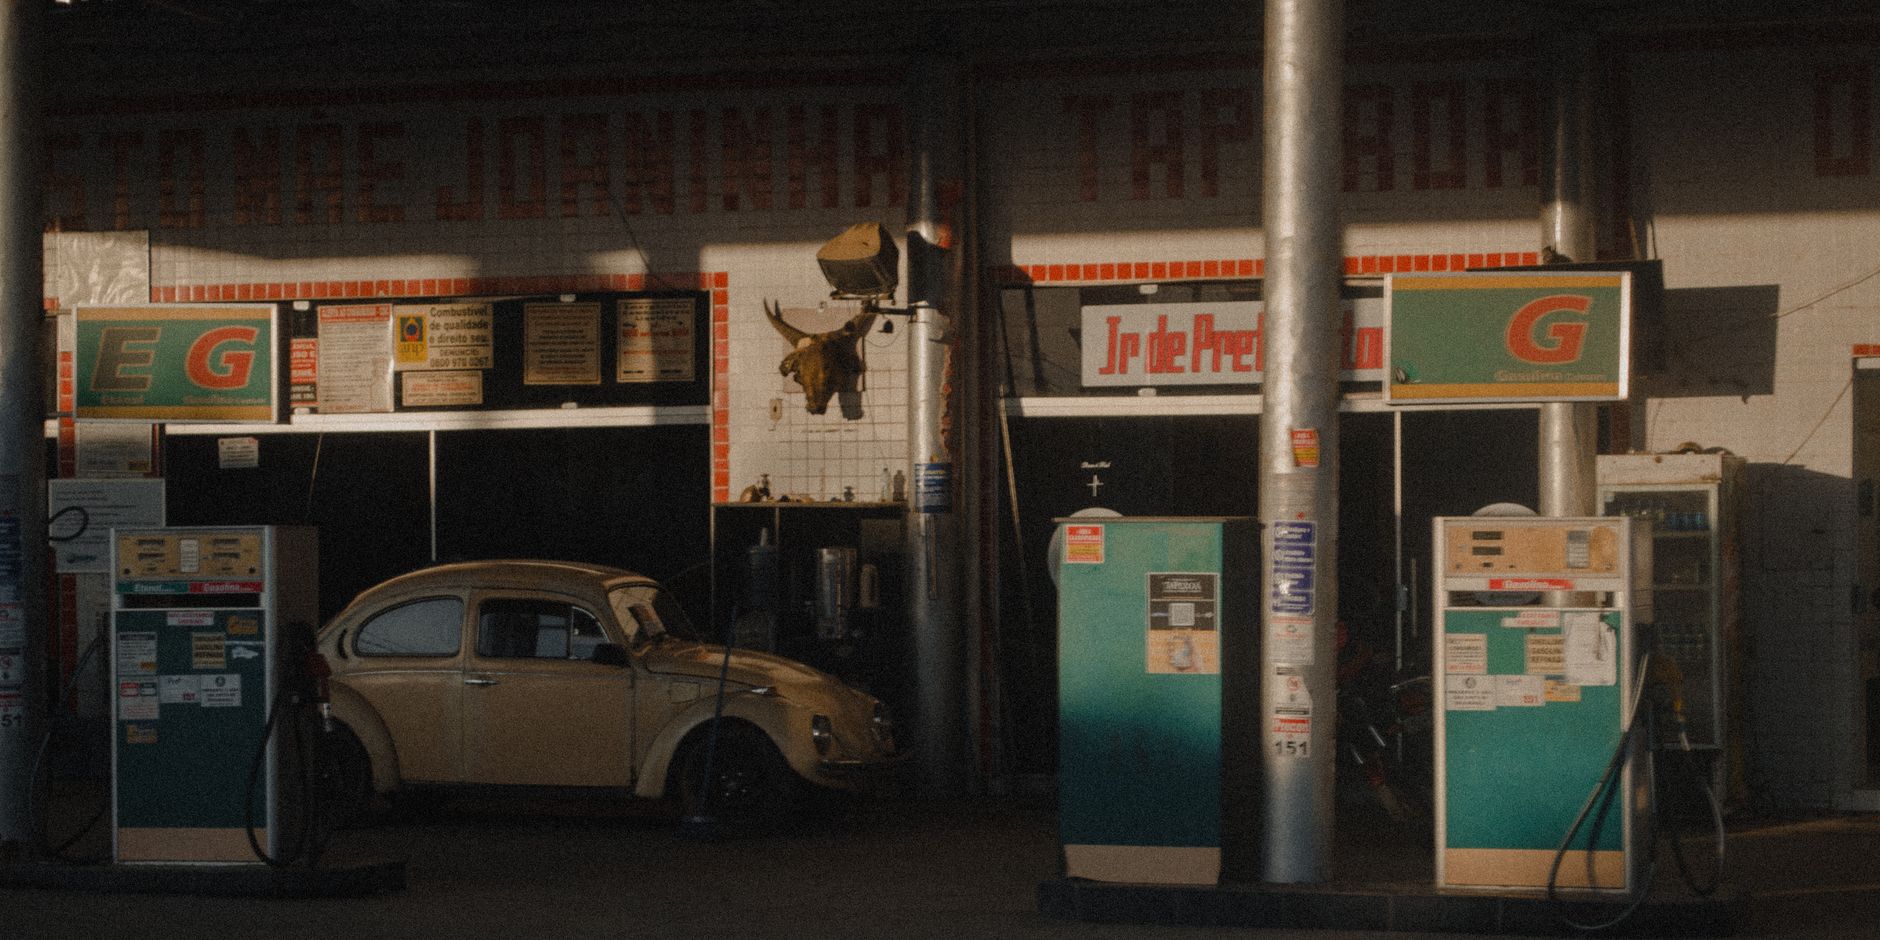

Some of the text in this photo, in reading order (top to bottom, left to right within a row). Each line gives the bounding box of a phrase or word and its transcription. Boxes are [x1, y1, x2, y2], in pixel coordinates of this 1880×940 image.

[436, 103, 903, 222] JOANINHA
[430, 305, 488, 317] Combustível
[429, 319, 489, 333] de qualidade
[1504, 293, 1593, 366] G
[437, 333, 467, 344] direito
[1098, 316, 1140, 375] Jr
[1146, 315, 1187, 374] de
[89, 326, 161, 392] E
[185, 324, 259, 391] G
[429, 358, 450, 368] 0800
[1275, 741, 1307, 756] 151
